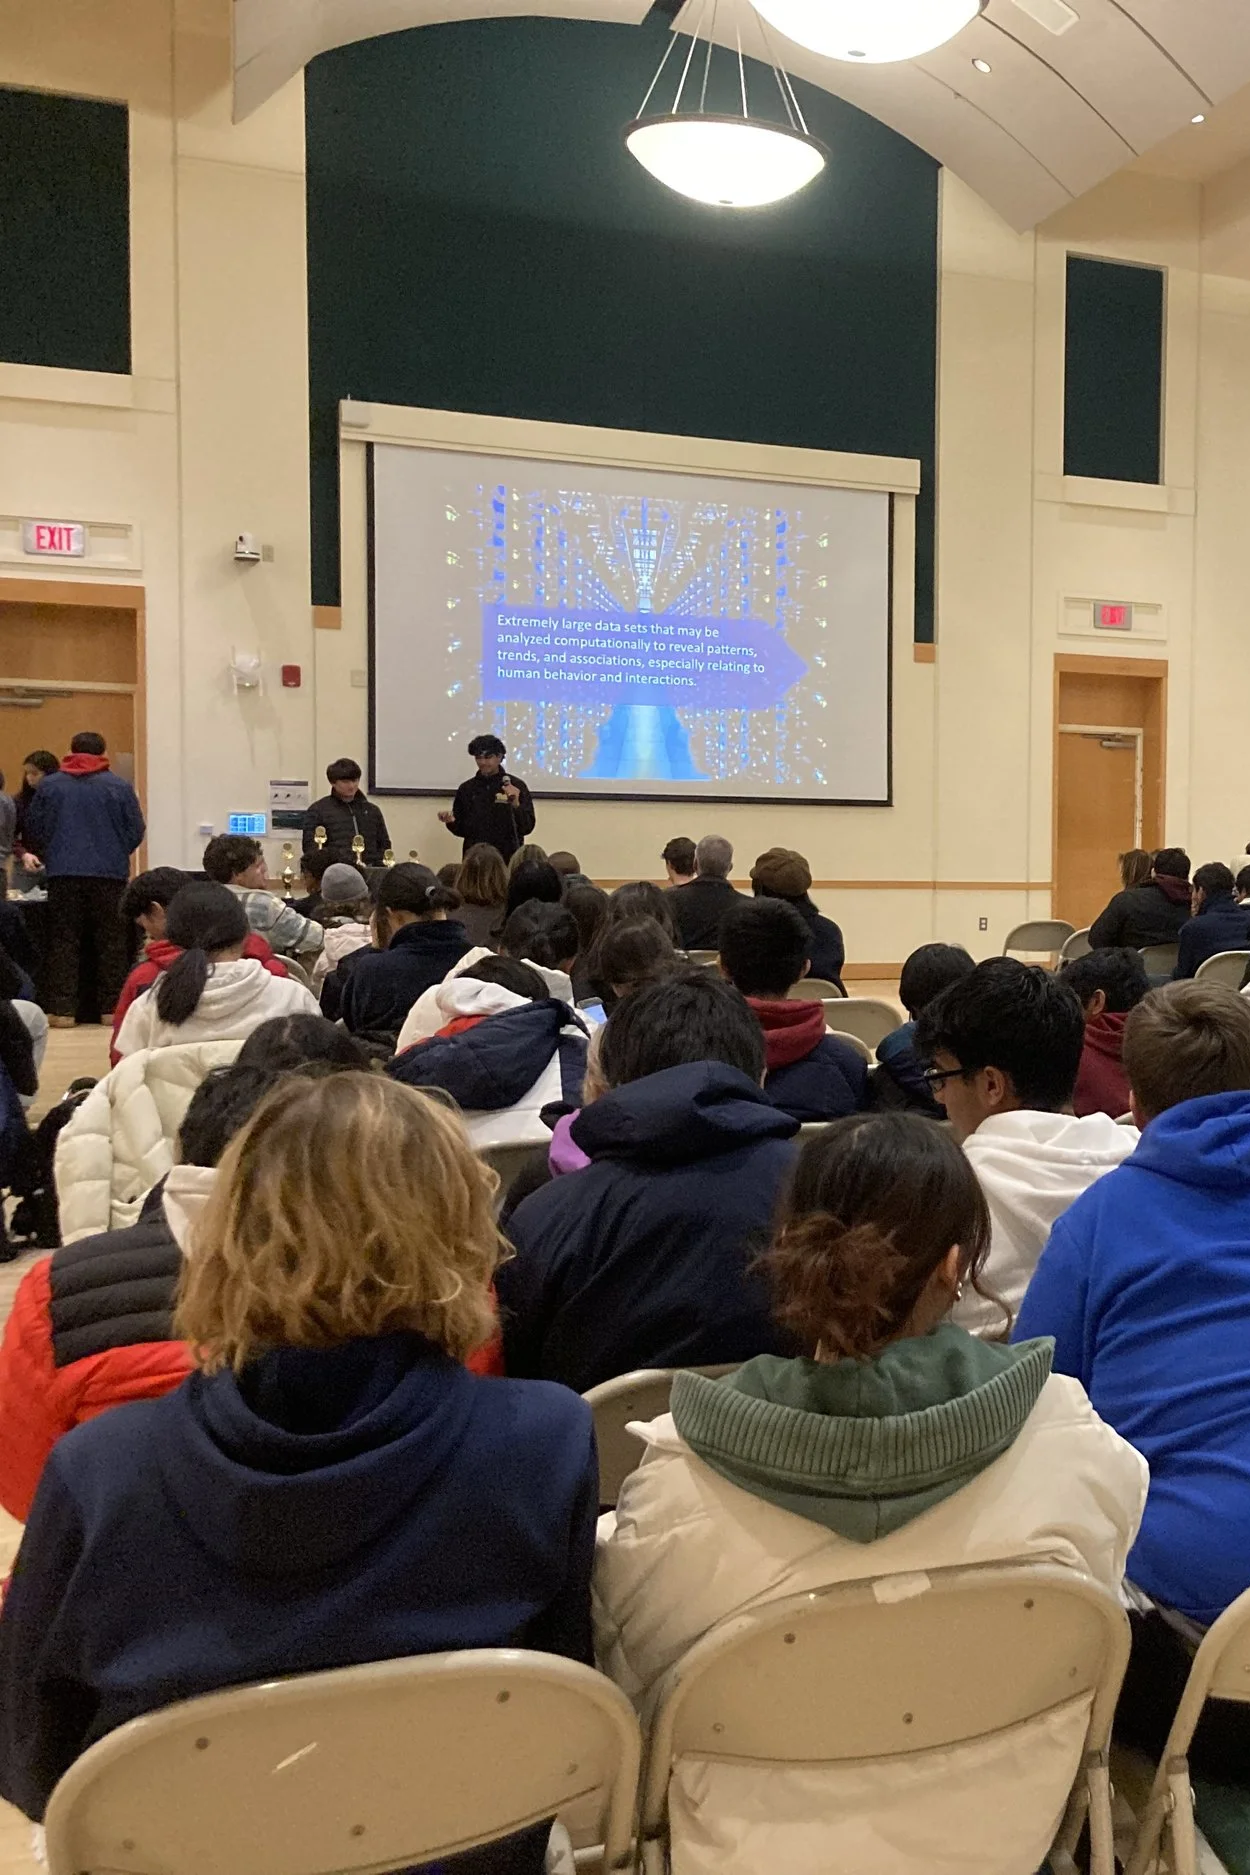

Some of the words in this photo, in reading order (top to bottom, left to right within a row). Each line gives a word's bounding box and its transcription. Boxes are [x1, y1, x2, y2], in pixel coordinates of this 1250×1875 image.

[36, 524, 75, 551] EXIT
[497, 614, 559, 631] Extremely
[562, 617, 592, 632] large
[594, 619, 621, 632] data
[624, 623, 648, 633] sets
[650, 623, 675, 635] that
[677, 627, 702, 639] may
[704, 626, 719, 638] be
[497, 632, 551, 646] analyzed
[554, 636, 651, 653] computationally
[653, 641, 666, 651] to
[669, 642, 704, 653] reveal
[707, 645, 758, 658] patterns,
[497, 650, 540, 663] trends,
[544, 652, 567, 663] and
[570, 654, 645, 668] associations,
[648, 658, 705, 672] especially
[707, 660, 751, 674] relating
[753, 663, 765, 673] to
[497, 666, 540, 679] human
[544, 668, 598, 681] behavior
[600, 672, 622, 683] and
[625, 672, 697, 686] interactions.
